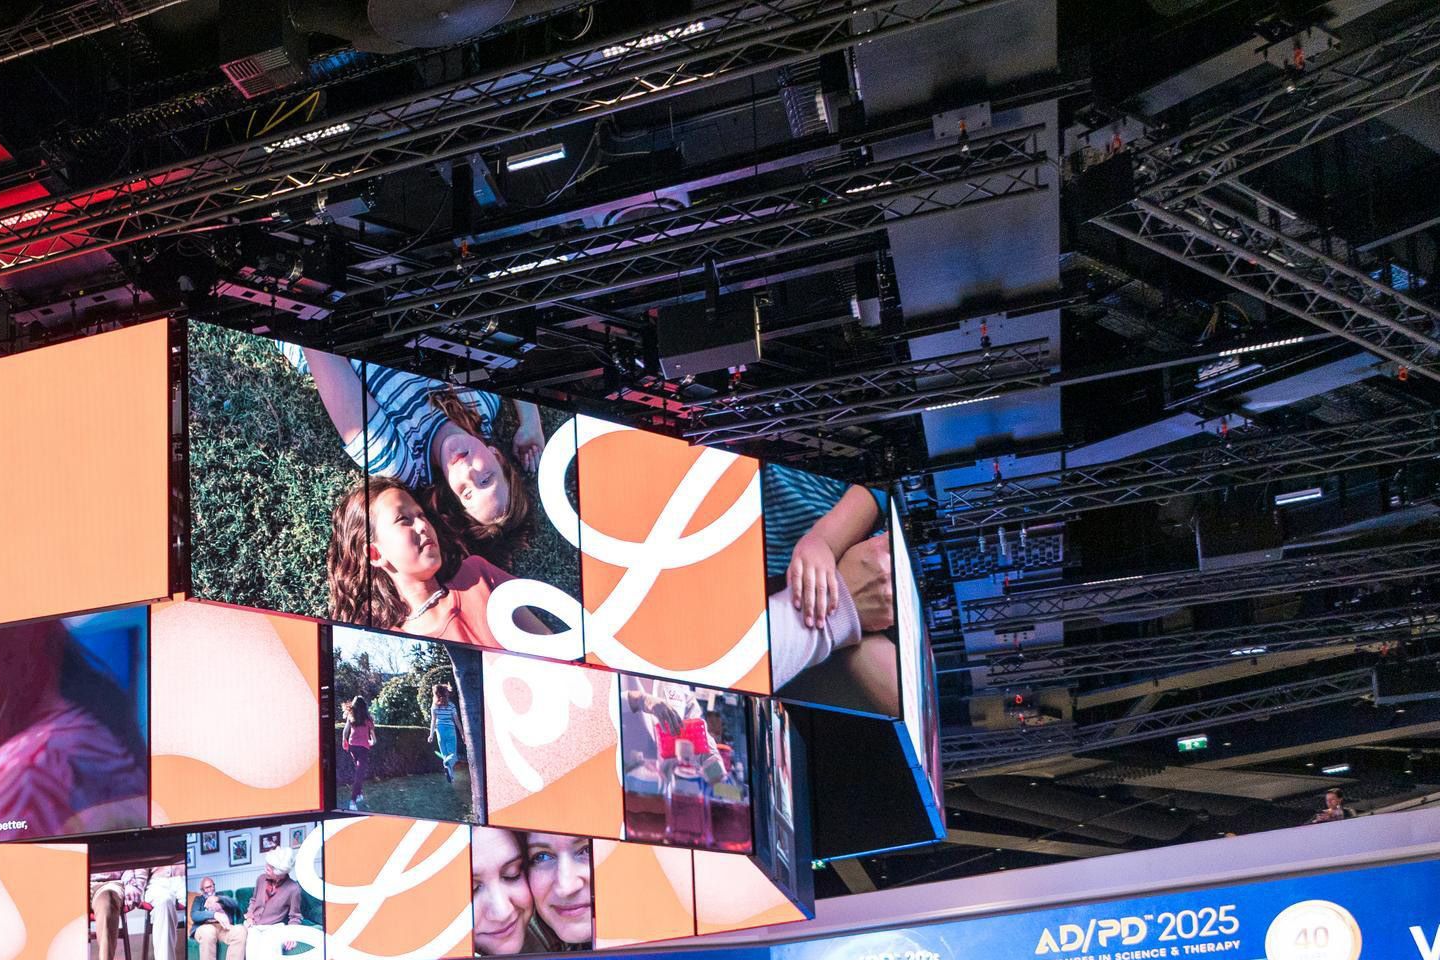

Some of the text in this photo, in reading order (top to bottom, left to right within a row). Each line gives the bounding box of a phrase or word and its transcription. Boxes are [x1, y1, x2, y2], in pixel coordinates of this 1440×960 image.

[1157, 904, 1240, 941] 2025
[1170, 947, 1179, 956] &
[1183, 940, 1241, 955] THERAPY
[1295, 926, 1329, 948] 40
